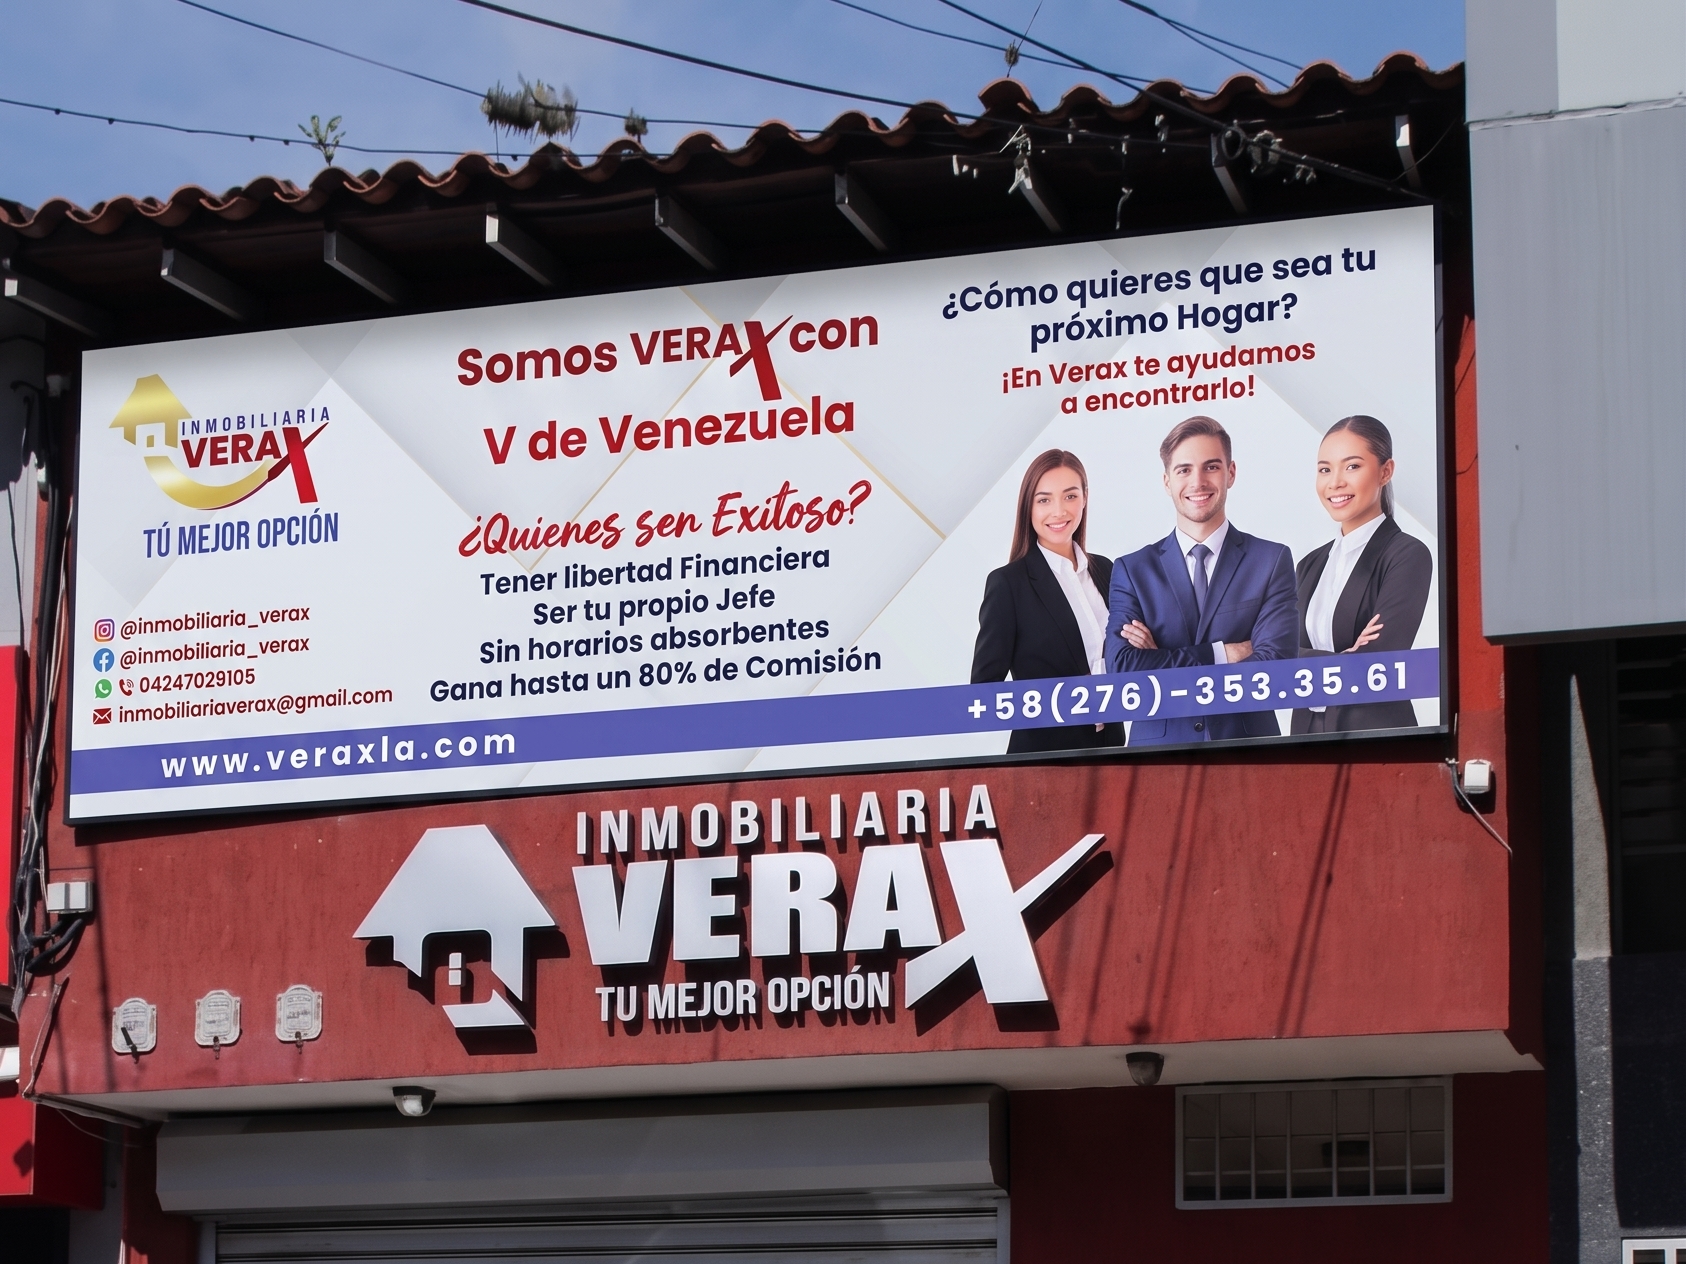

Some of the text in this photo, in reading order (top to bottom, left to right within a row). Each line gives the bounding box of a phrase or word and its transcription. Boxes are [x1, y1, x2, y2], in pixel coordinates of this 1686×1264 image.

[942, 247, 1377, 320] ¿Cómo quieres que sea tu
[1031, 293, 1298, 352] próximo Hogar?
[458, 315, 879, 401] Somos VERAX con
[1002, 340, 1316, 394] ¡En Verax te ayudamos
[181, 406, 330, 436] INMOBILIARIA
[1061, 375, 1255, 415] a encontrarlo!
[483, 395, 854, 465] V de Venezuela
[180, 421, 330, 503] VERAX
[144, 508, 339, 558] TÚ MEJOR OPCIÓN
[458, 510, 625, 557] ¿Quienes
[712, 479, 872, 537] Exitoso?
[481, 546, 830, 595] Tener libertad Financiera
[120, 607, 310, 640] @inmobiliaria_verax
[533, 584, 776, 625] Ser tu propio Jefe
[120, 637, 309, 670] @inmobiliaria_verax
[480, 616, 829, 664] Sin horarios absorbentes
[139, 668, 255, 694] 04247029105
[430, 647, 881, 702] Gana hasta un 80% de Comisión
[968, 661, 1406, 723] +58(276)-353.35.61
[119, 687, 392, 724] inmobiliariaverax@gmail.com
[161, 732, 516, 778] www.veraxla.com
[576, 783, 997, 854] INMOBILIARIA
[572, 833, 1104, 1009] VERAX
[596, 965, 890, 1022] TU MEJOR OPCIÓN
